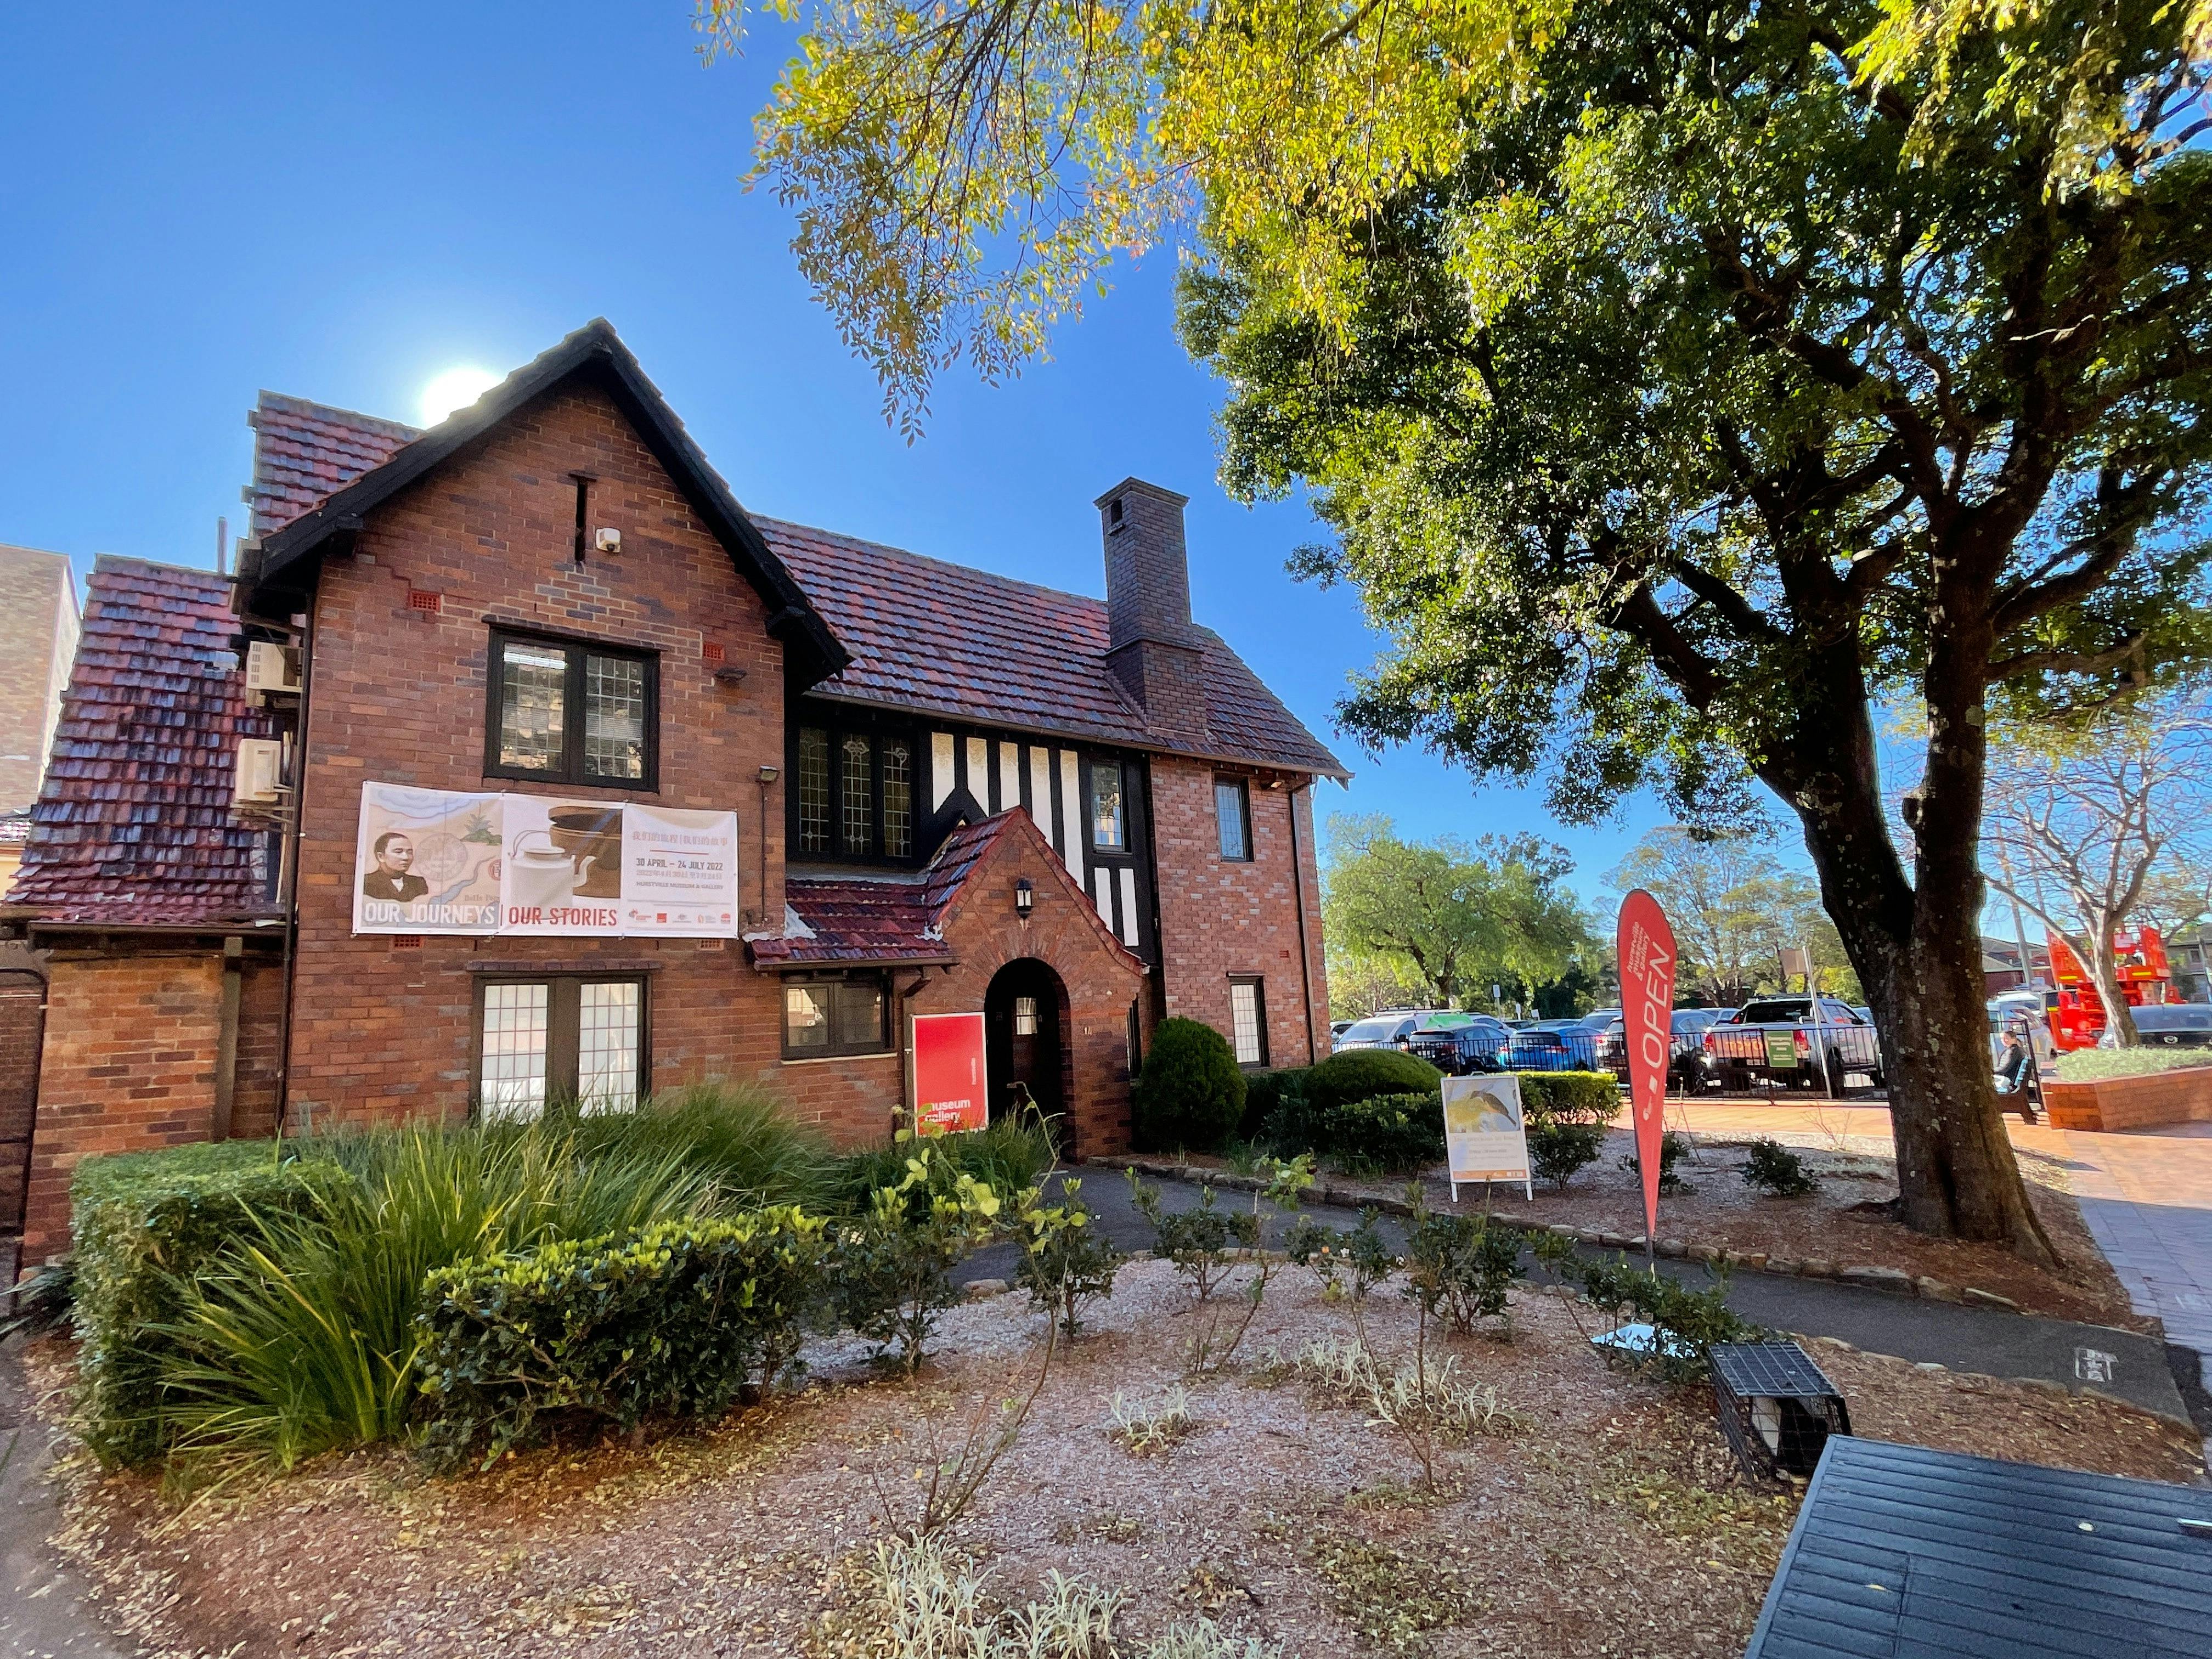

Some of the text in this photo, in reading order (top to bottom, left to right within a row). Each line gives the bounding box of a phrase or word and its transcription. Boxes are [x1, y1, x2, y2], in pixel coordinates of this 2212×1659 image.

[636, 857, 645, 866] 30
[647, 858, 668, 868] APRIL
[678, 860, 686, 868] 24
[688, 861, 705, 870] JULY
[707, 862, 723, 871] 2022
[364, 902, 401, 923] OUR
[404, 903, 495, 926] JOURNEYS
[509, 906, 541, 925] OUR
[550, 907, 617, 926] STORIES
[1643, 941, 1670, 1068] OPEN
